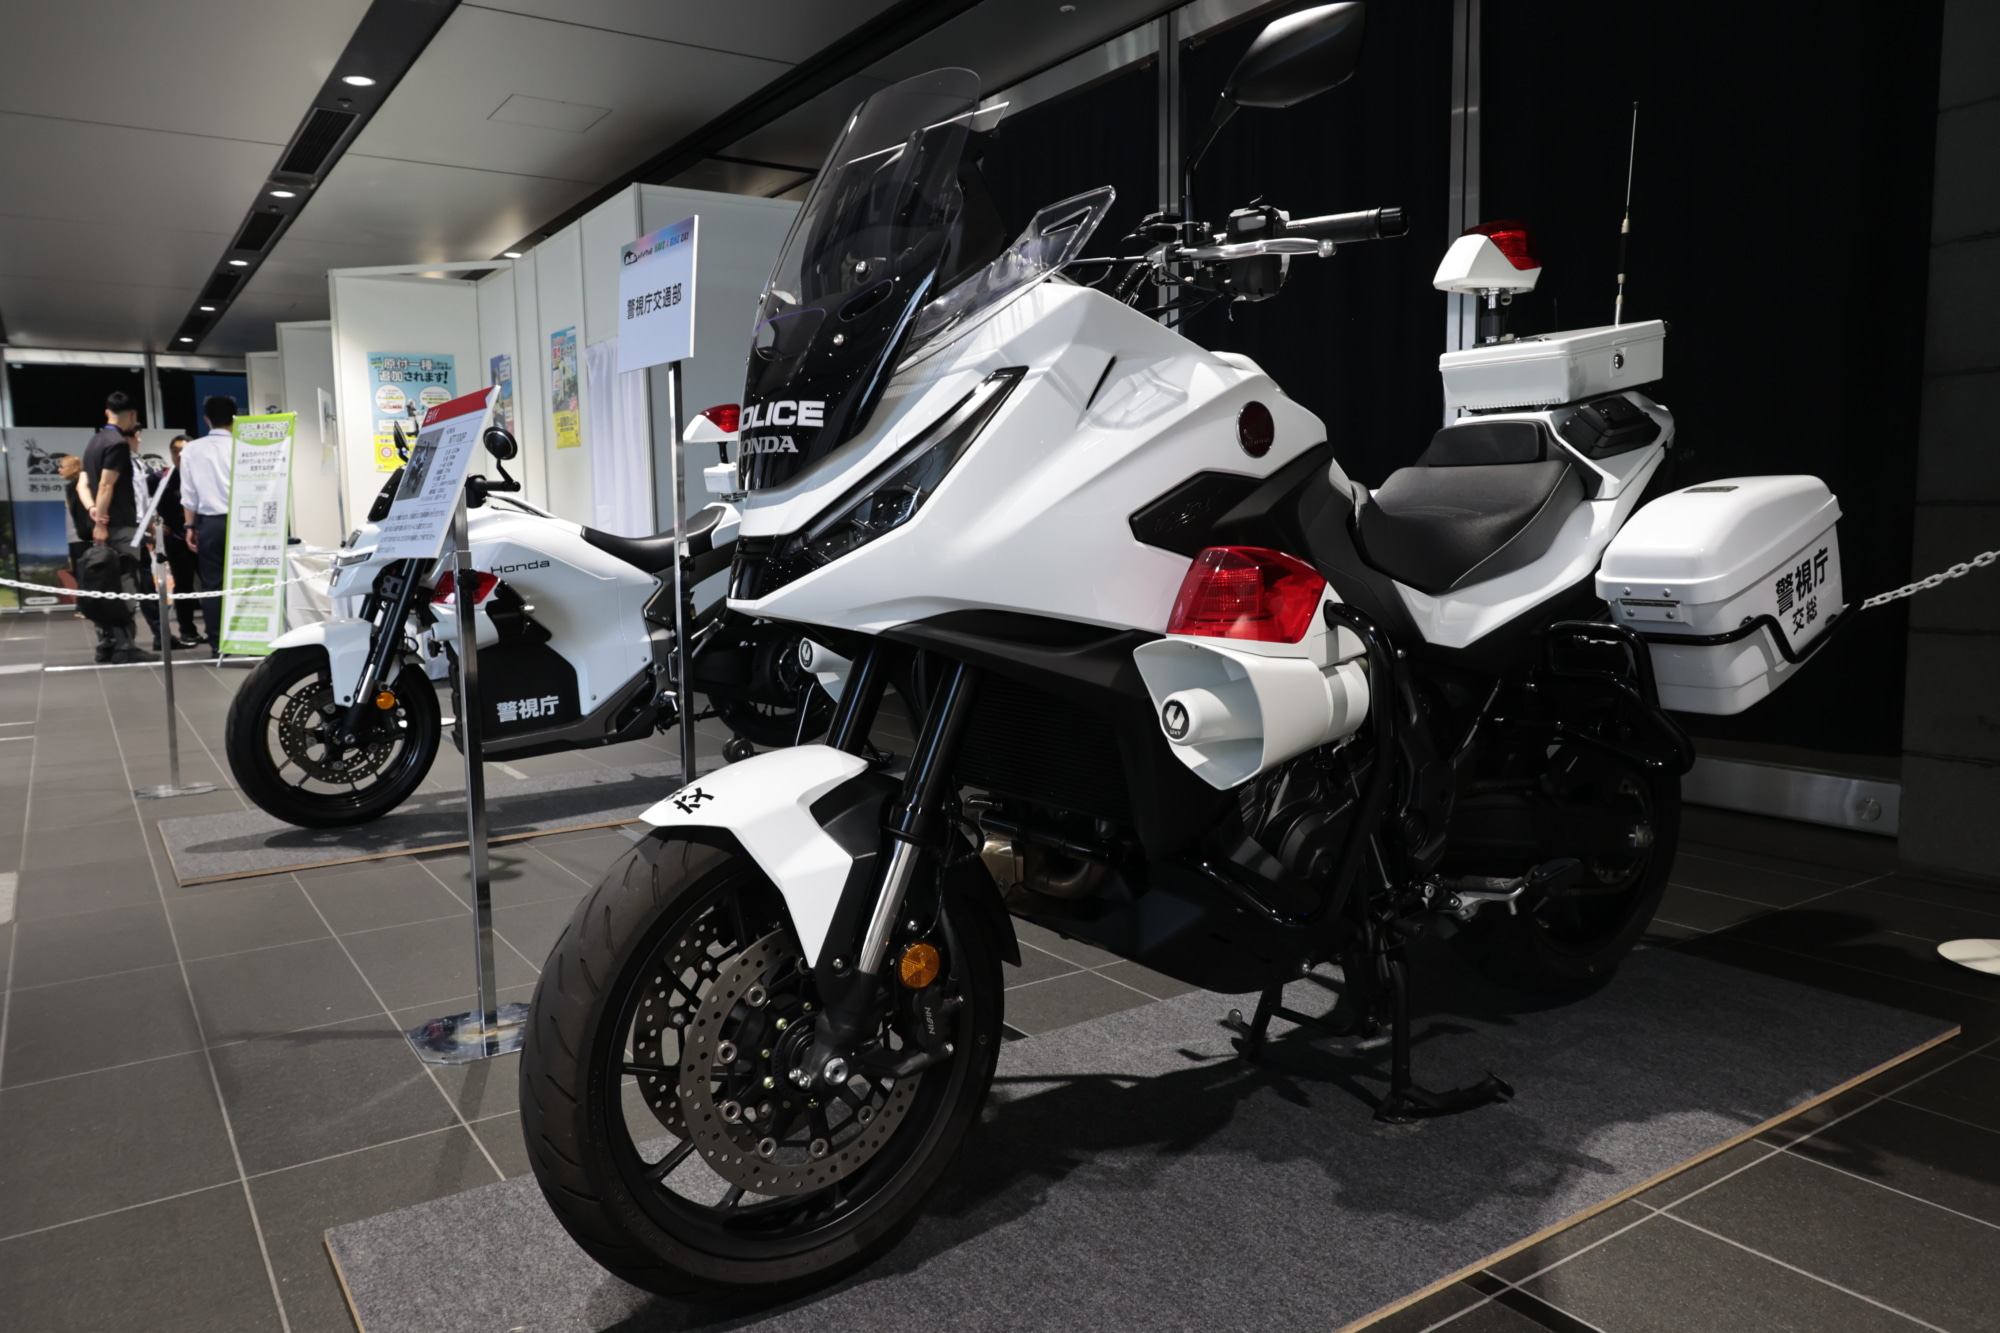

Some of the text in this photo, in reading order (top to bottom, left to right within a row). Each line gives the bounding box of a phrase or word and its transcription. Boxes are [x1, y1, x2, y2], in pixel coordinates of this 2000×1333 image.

[627, 282, 682, 320] 警視庁交通部
[741, 400, 825, 432] OLICE
[740, 435, 799, 456] ONDA
[490, 560, 550, 574] Honda
[1776, 547, 1828, 617] 警視庁
[1792, 596, 1817, 636] 交総
[496, 695, 559, 723] 警視庁
